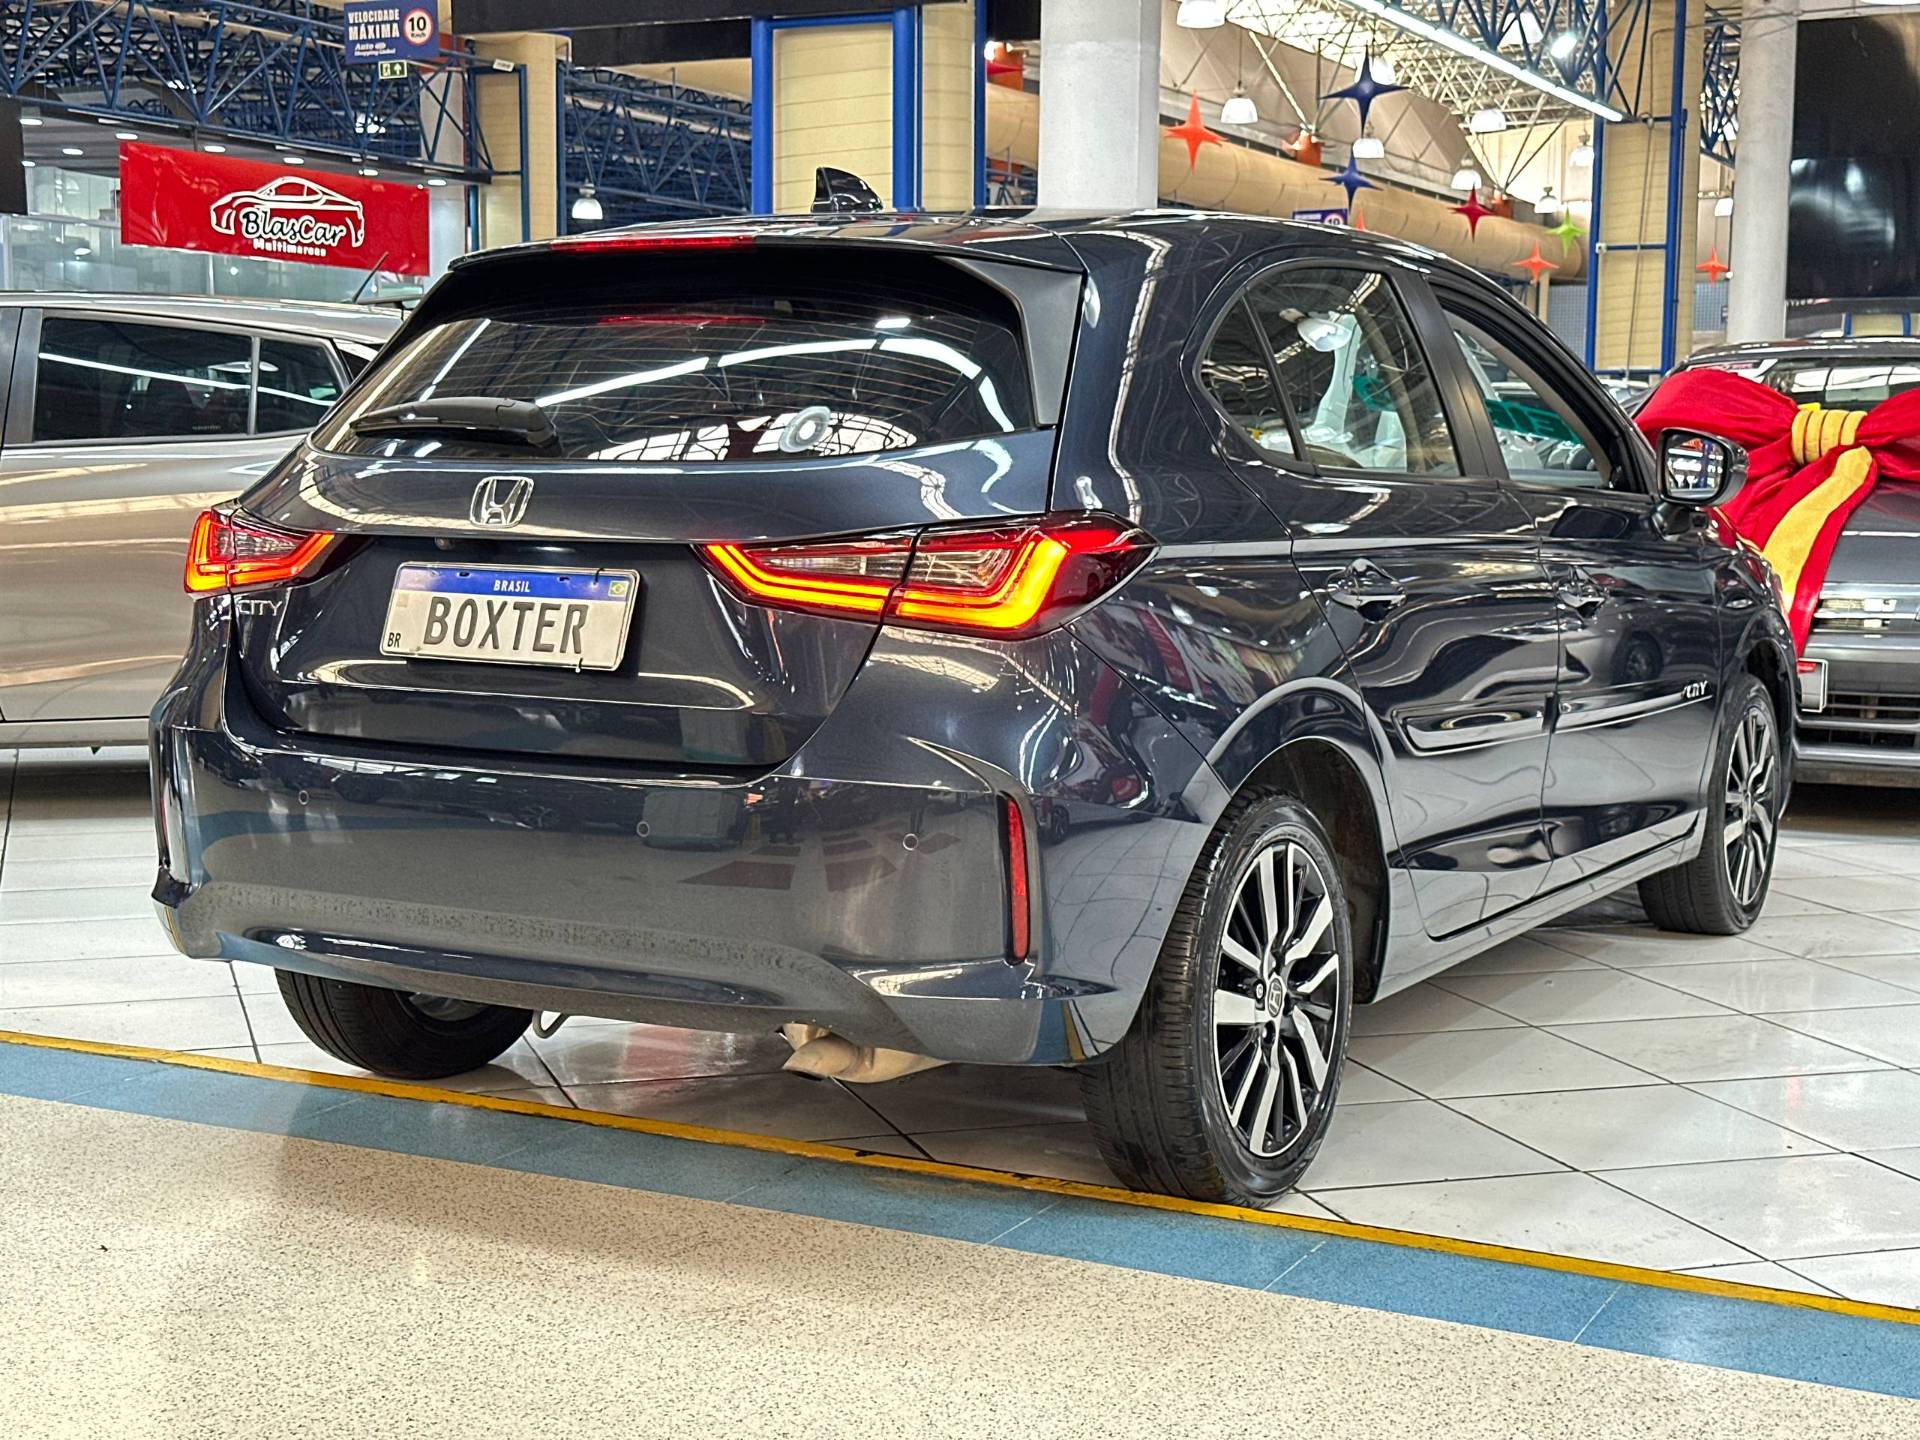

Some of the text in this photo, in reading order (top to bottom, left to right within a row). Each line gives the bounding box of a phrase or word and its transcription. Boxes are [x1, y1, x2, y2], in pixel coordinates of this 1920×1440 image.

[348, 9, 400, 23] VELOCIDADE
[408, 16, 427, 31] 10
[348, 23, 400, 41] MÁXIMA
[239, 207, 346, 246] BlasCar
[253, 238, 326, 256] Multimarcas
[493, 579, 531, 593] BRASIL
[236, 598, 283, 617] CITY
[423, 596, 589, 654] BOXTER
[387, 632, 401, 648] BR
